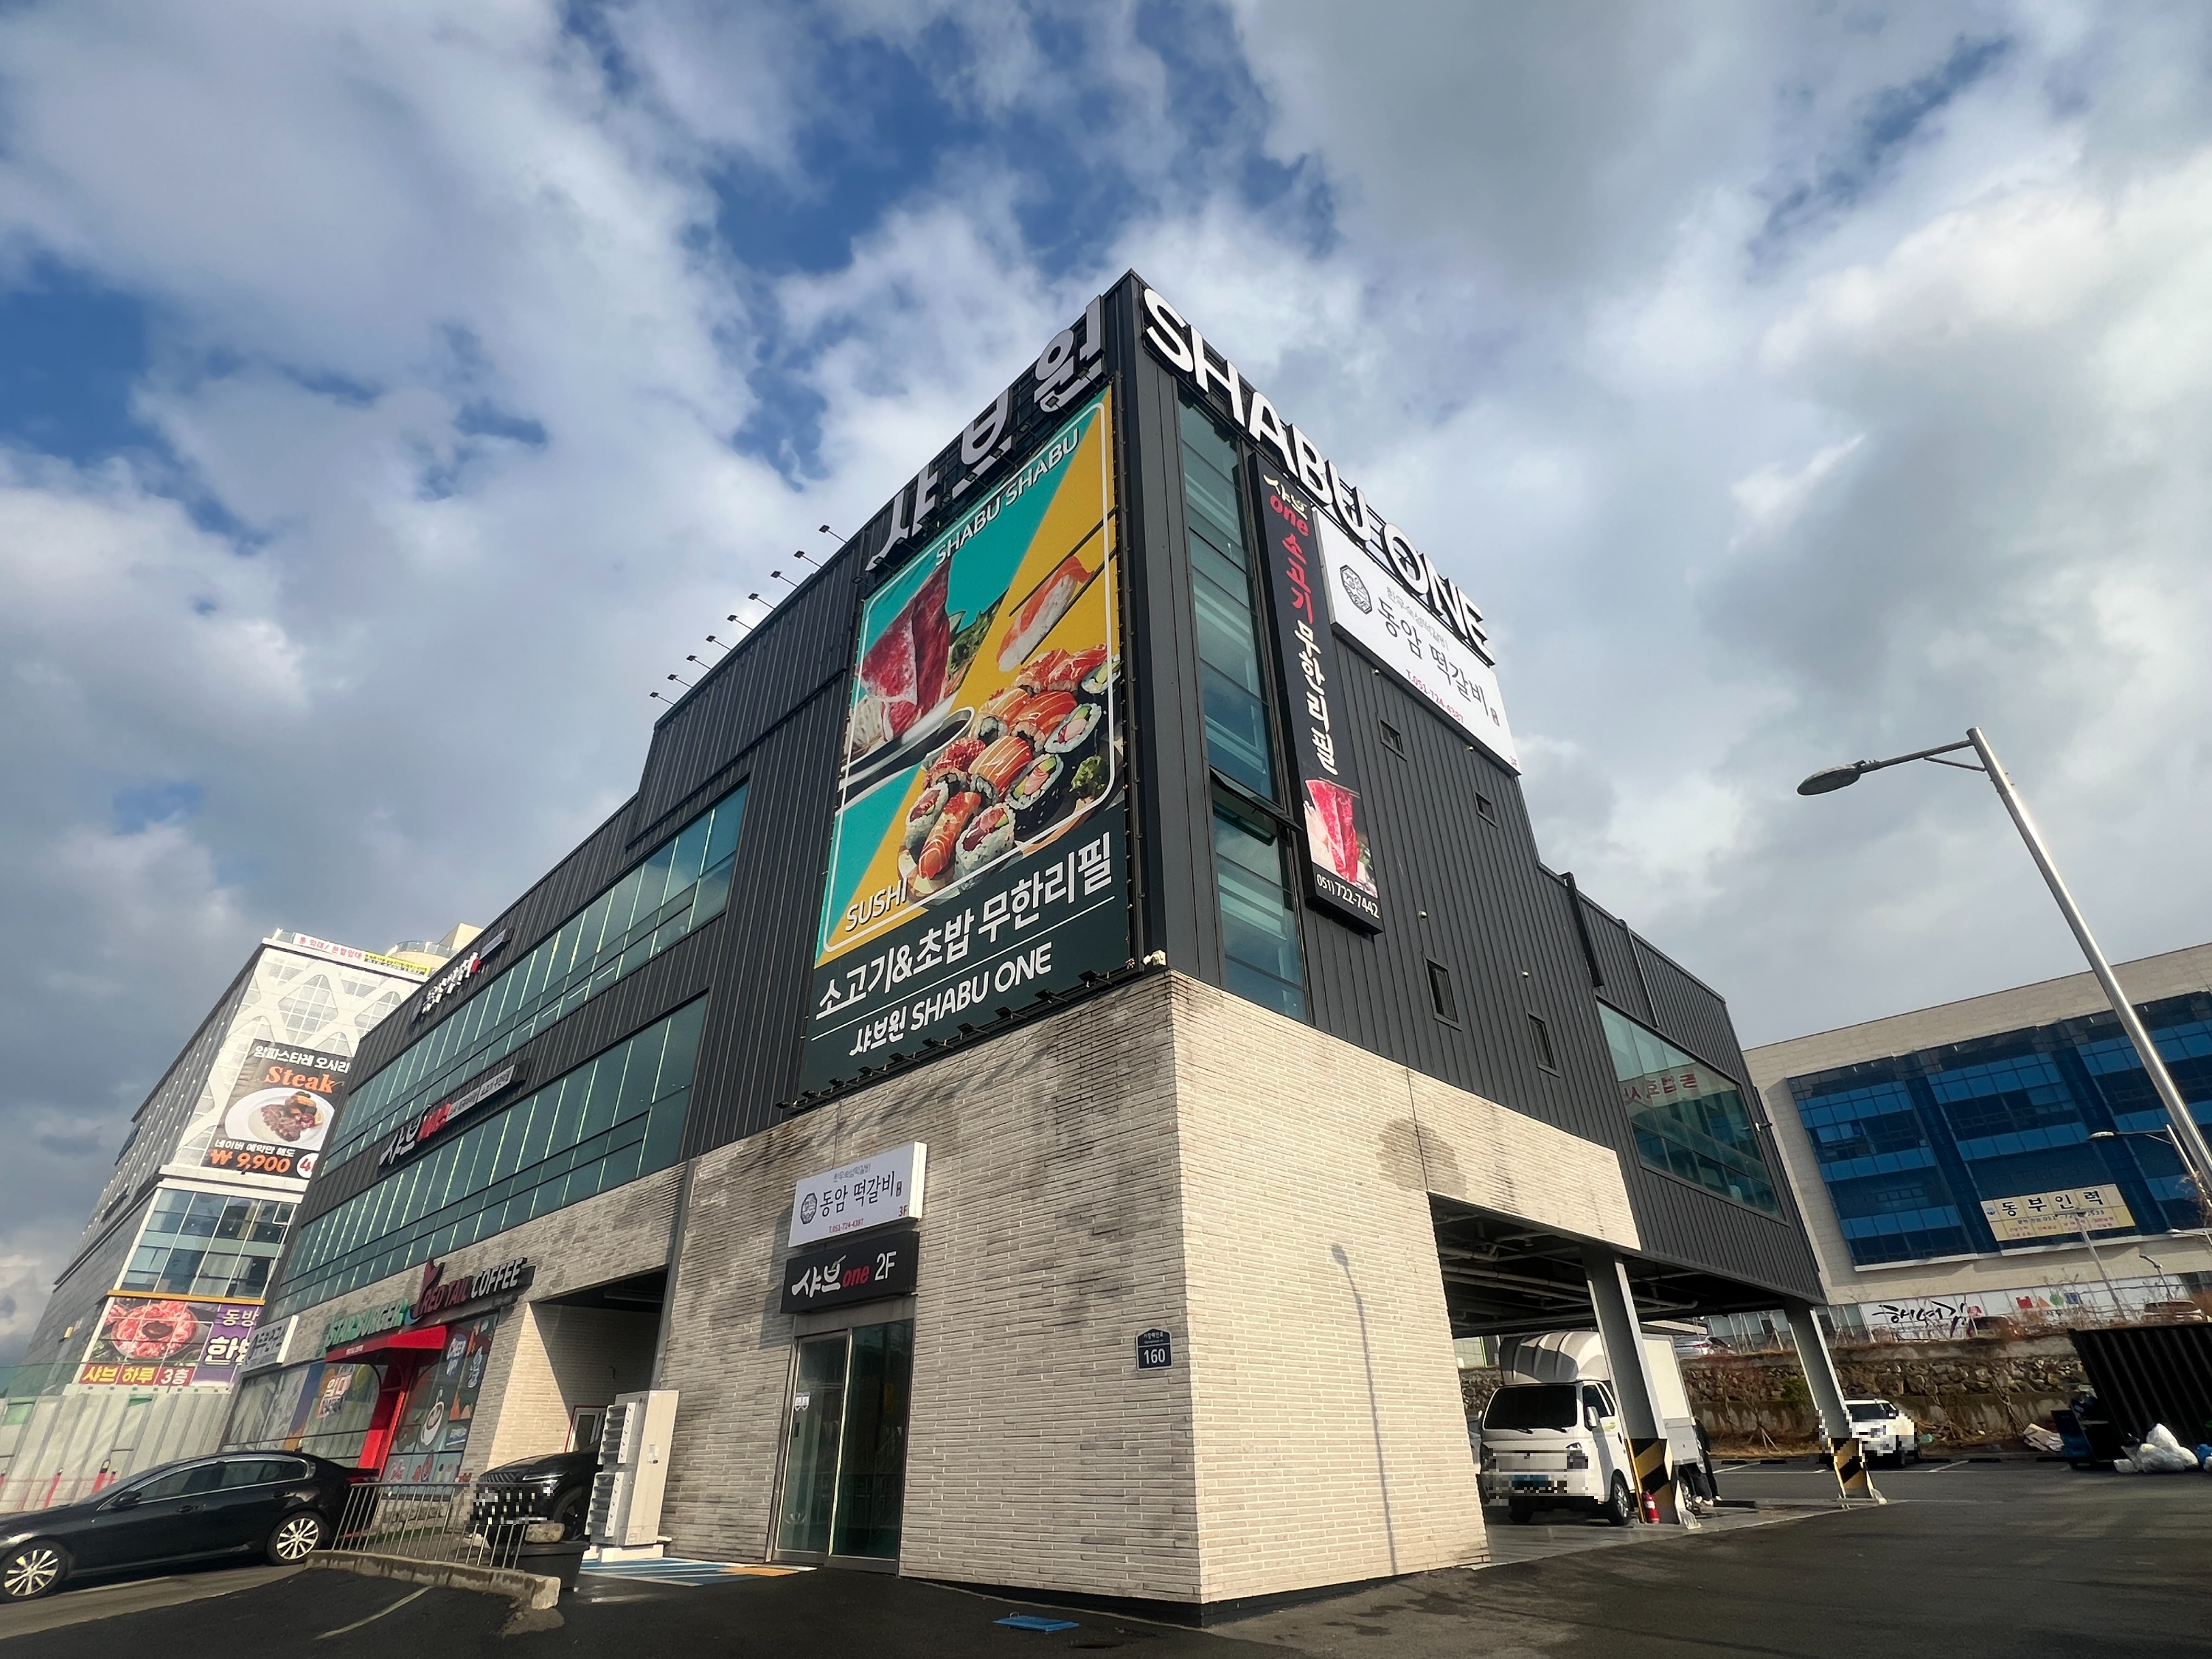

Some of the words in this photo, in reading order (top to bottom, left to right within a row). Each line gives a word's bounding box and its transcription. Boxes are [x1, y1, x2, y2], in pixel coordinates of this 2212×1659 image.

[936, 496, 1002, 567] SHABU
[1006, 428, 1079, 507] SHABU
[1143, 288, 1371, 541] SHABU
[1382, 524, 1495, 666] ONE
[1263, 474, 1308, 521] 샤브
[1270, 495, 1310, 537] one
[1281, 533, 1313, 625] 소고기
[1377, 597, 1422, 660] 동암
[1429, 643, 1489, 717] 떡갈비
[1294, 620, 1338, 775] 무한리필
[846, 876, 910, 932] SUSHI
[1316, 873, 1380, 919] 051)722-7442
[816, 908, 975, 1021] 소고기&초밥
[978, 832, 1113, 945] 무한리필
[849, 1006, 906, 1057] 샤브원
[911, 970, 990, 1031] SHABU
[995, 942, 1053, 992] ONE
[264, 1065, 336, 1093] Steak
[215, 1139, 245, 1150] 네이버
[246, 1143, 276, 1155] 예약만
[276, 1147, 296, 1158] 해도
[236, 1152, 291, 1174] 9,900
[820, 1185, 848, 1217] 동암
[854, 1171, 895, 1207] 떡갈비
[898, 1205, 908, 1217] 3F
[2002, 1190, 2104, 1217] 동부인력
[470, 1257, 524, 1298] COFFEE
[874, 1251, 897, 1281] 2F
[222, 1308, 259, 1327] 동방
[83, 1365, 122, 1382] 샤브
[122, 1366, 154, 1383] 하루
[160, 1367, 190, 1385] 3층
[1144, 1348, 1166, 1365] 160
[325, 1375, 352, 1398] 임대
